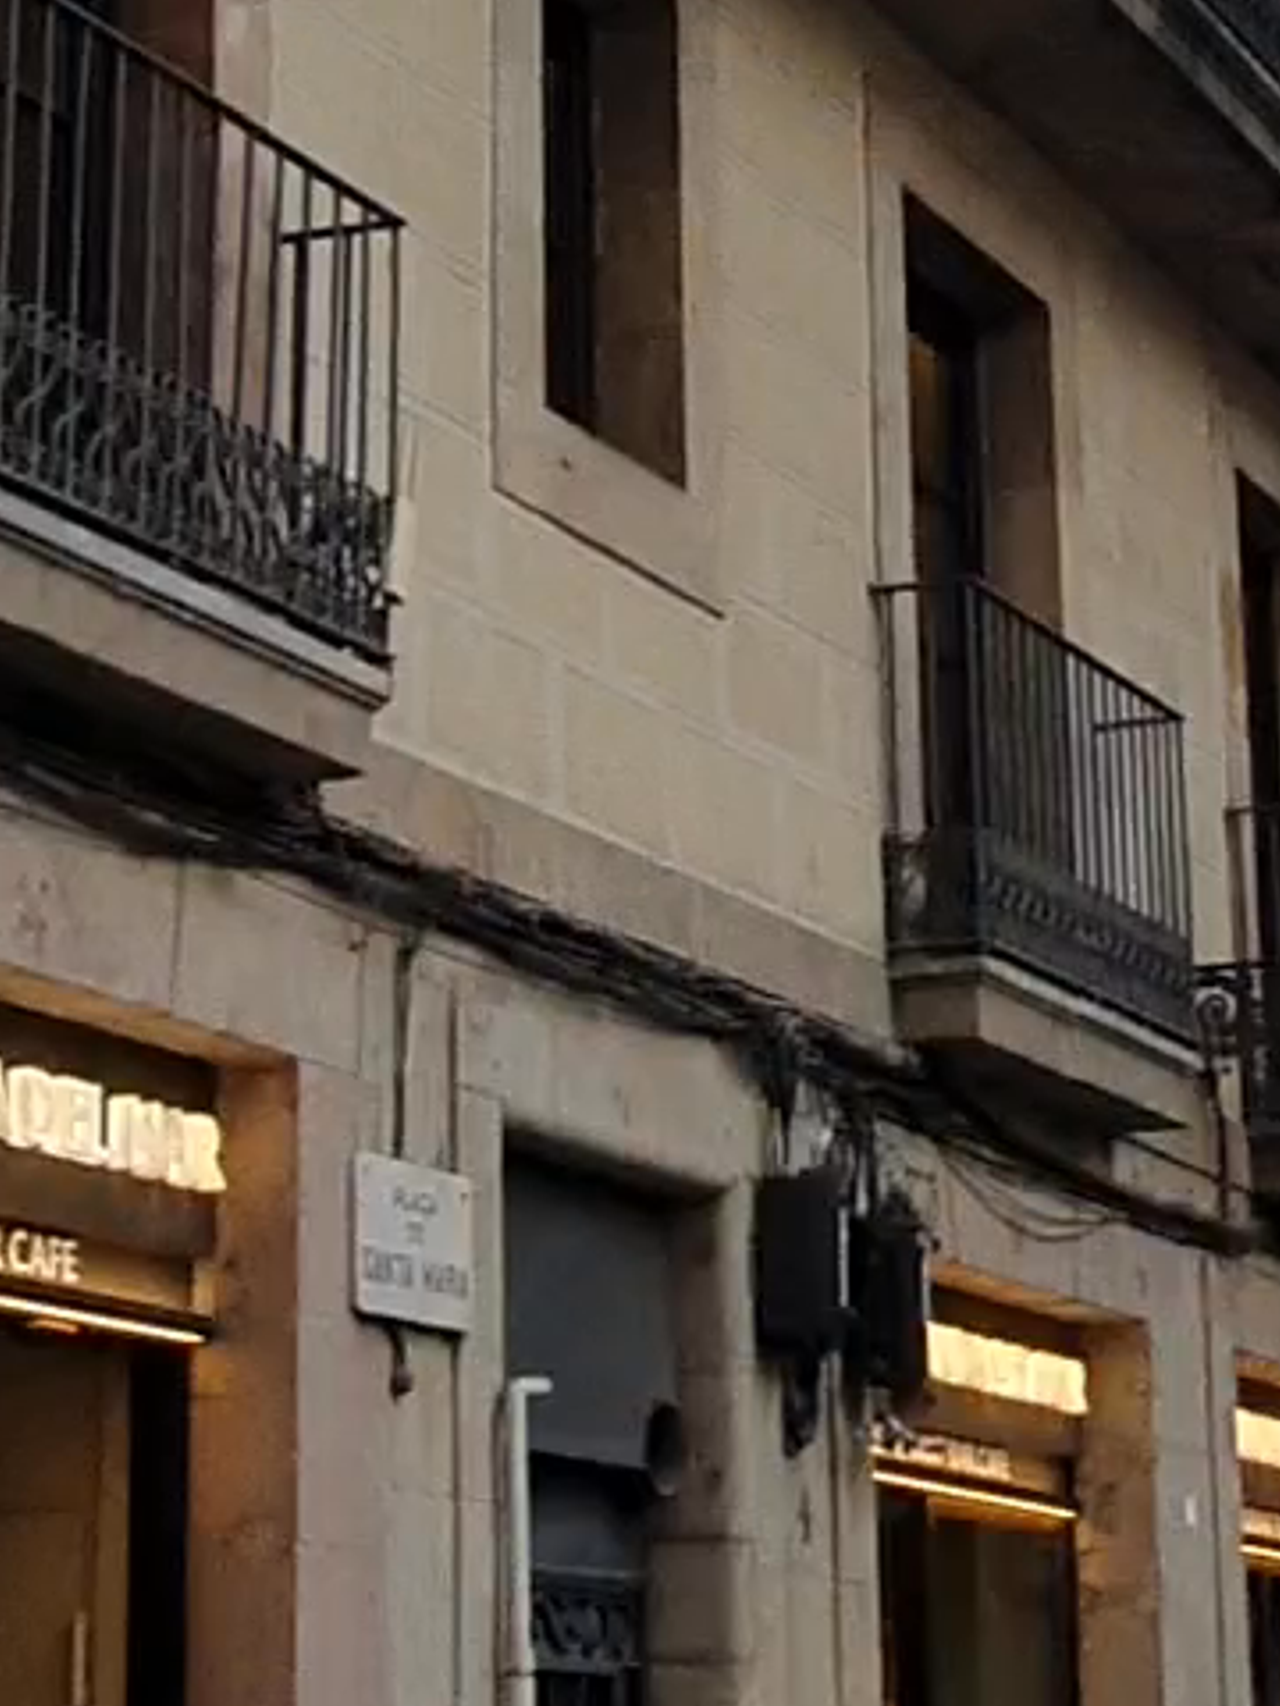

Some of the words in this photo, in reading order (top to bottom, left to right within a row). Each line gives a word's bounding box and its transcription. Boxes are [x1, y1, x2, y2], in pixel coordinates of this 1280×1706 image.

[4, 1065, 109, 1167] DEL
[106, 1094, 227, 1193] MAR
[8, 1229, 81, 1284] CAFE
